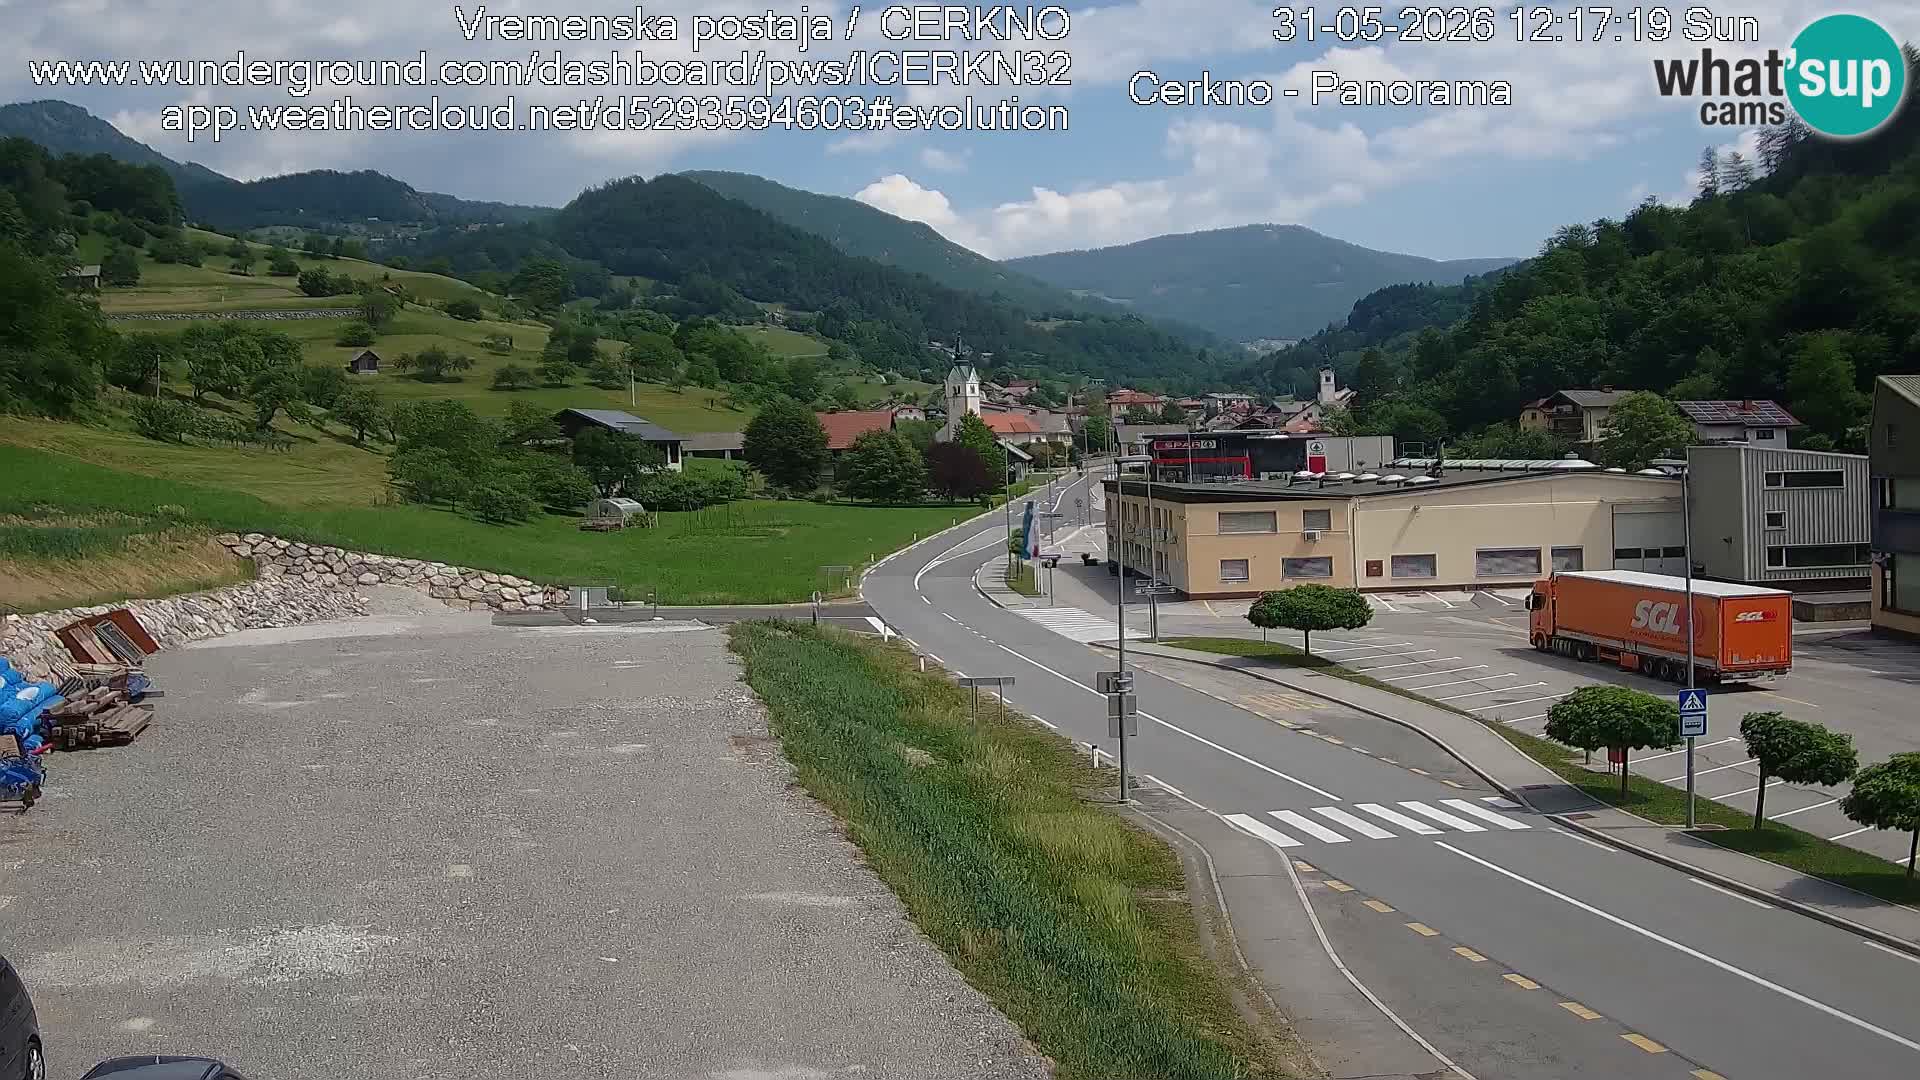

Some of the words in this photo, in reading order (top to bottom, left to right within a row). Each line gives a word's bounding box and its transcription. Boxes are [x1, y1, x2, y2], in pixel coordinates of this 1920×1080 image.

[1165, 441, 1201, 449] SPAR
[1630, 600, 1680, 635] SGL
[1735, 611, 1764, 622] SGL
